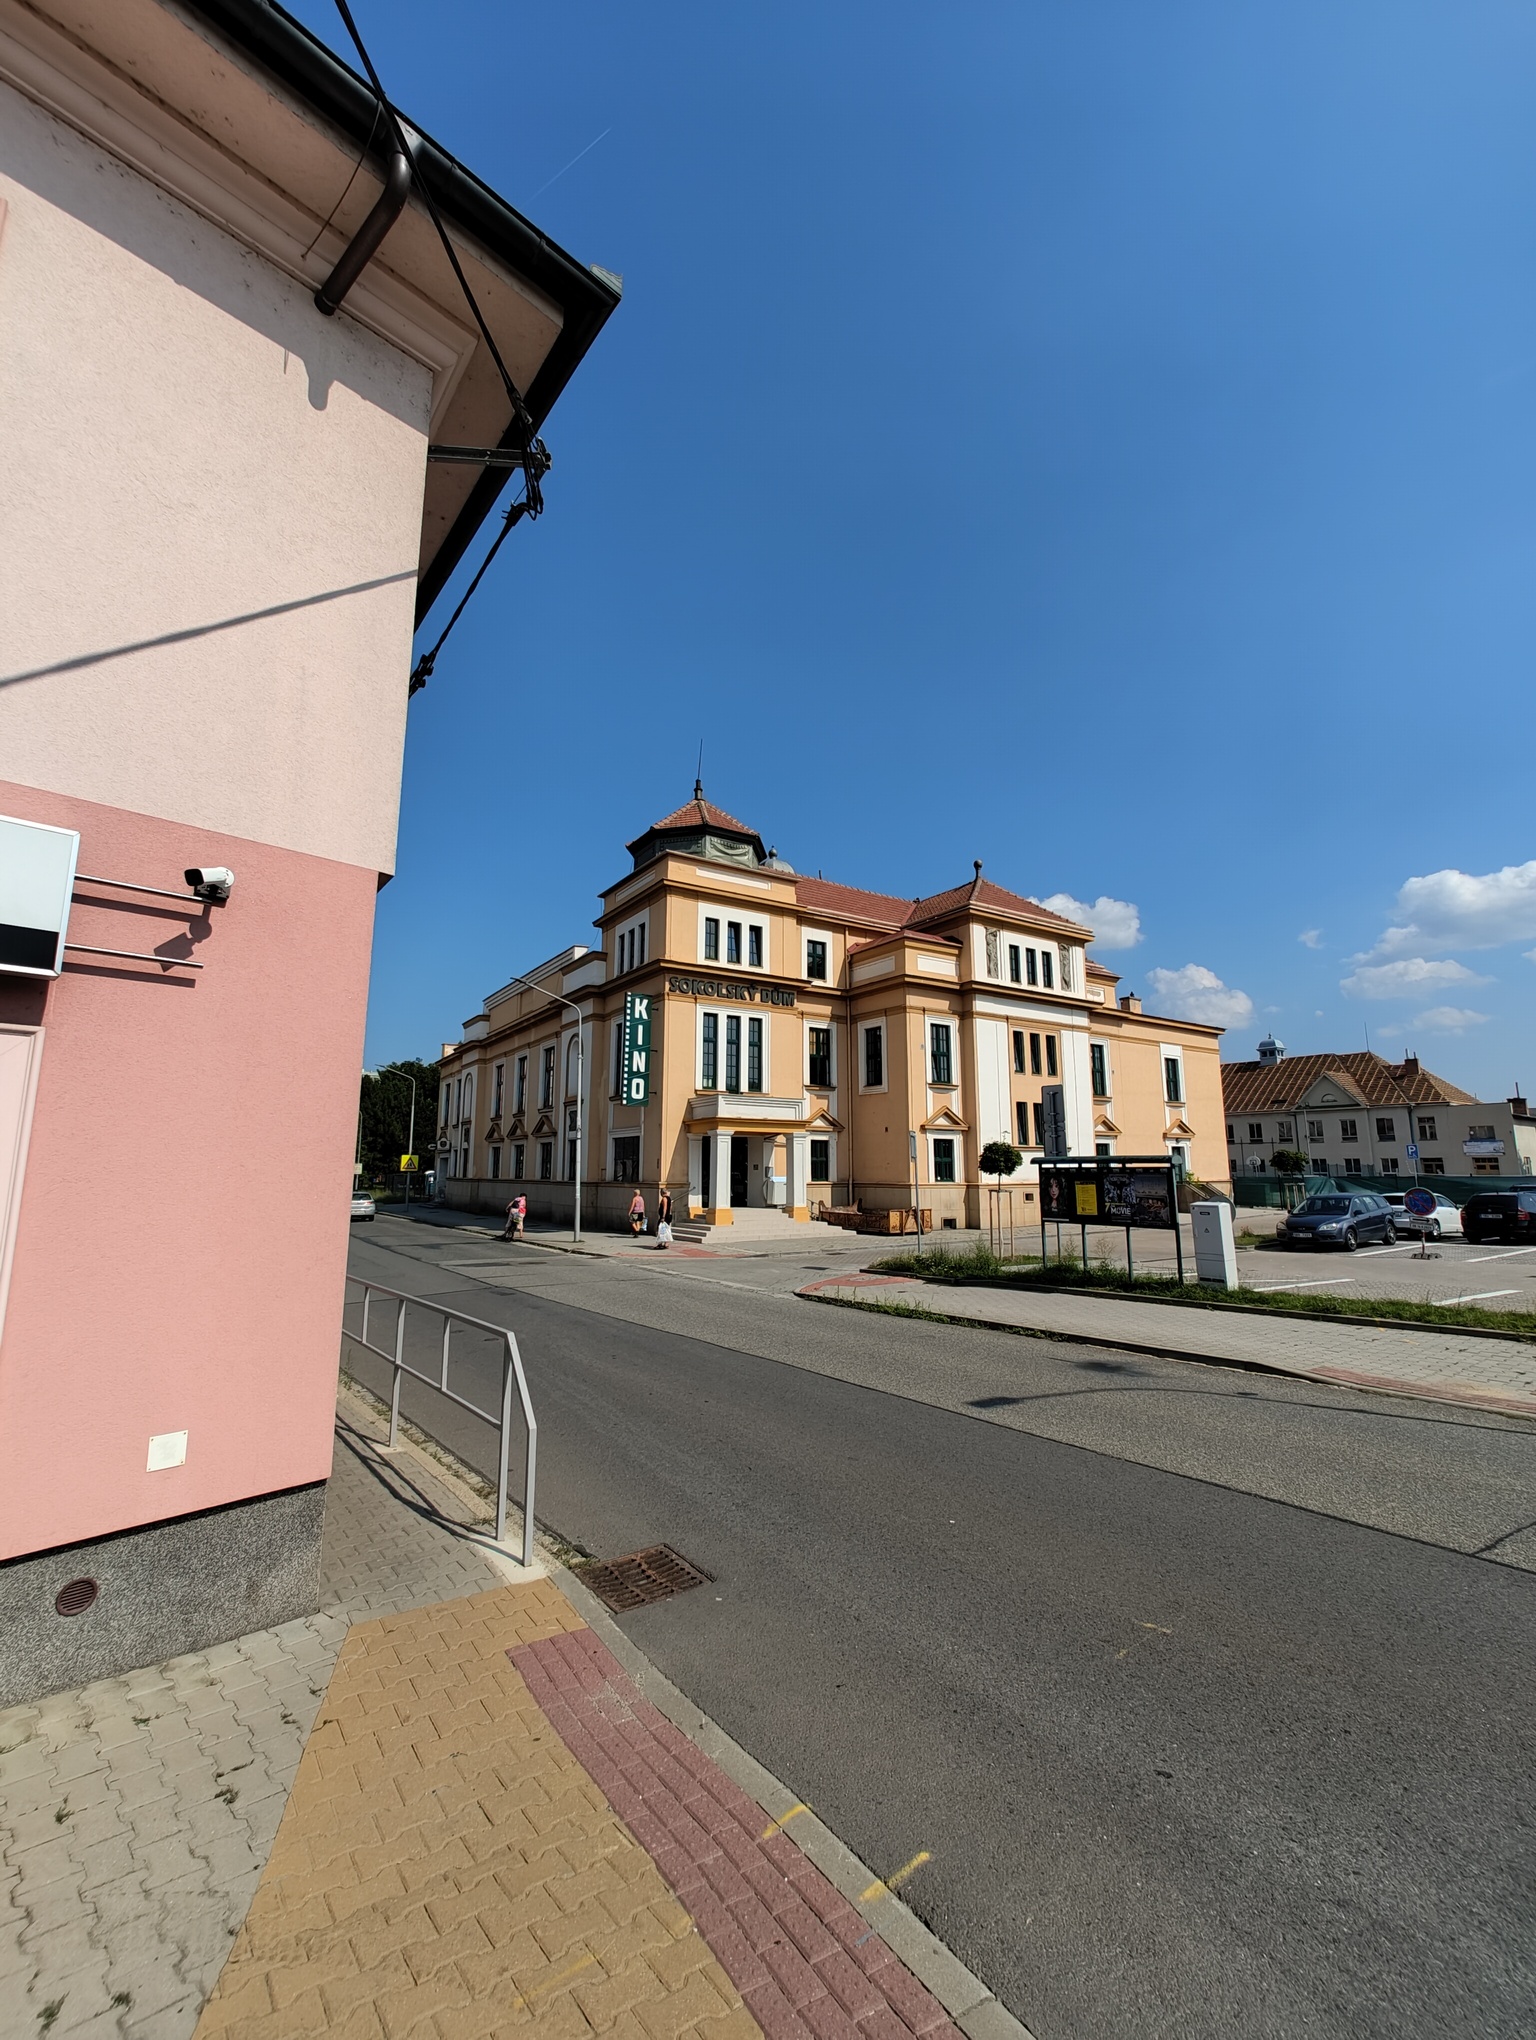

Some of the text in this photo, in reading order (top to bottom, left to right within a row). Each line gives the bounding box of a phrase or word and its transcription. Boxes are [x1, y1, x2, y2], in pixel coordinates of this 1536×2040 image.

[669, 976, 758, 1001] SOKOLSKÝ
[631, 998, 648, 1100] KINO
[1408, 1146, 1415, 1155] P
